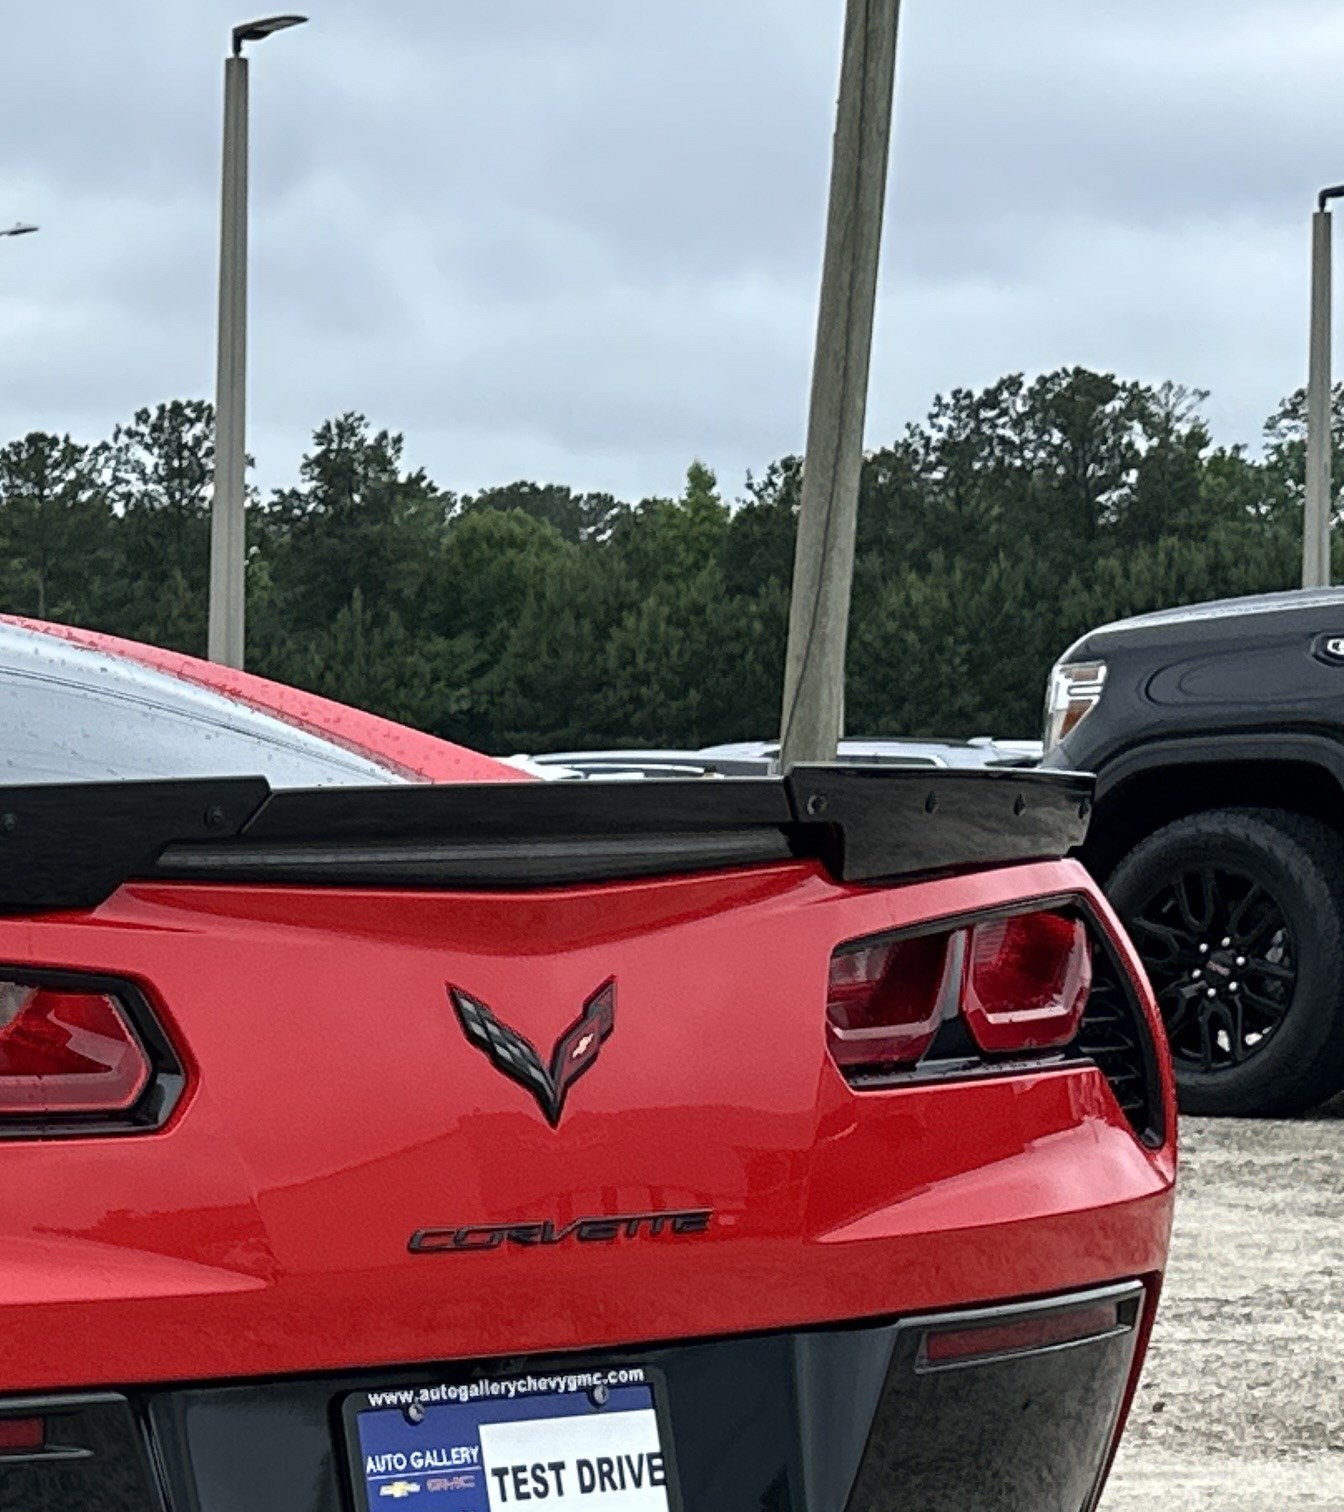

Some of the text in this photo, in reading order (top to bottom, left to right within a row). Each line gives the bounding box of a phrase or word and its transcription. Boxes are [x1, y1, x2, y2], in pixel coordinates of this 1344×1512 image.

[407, 1208, 714, 1254] CORVETTE
[367, 1368, 644, 1407] www.autogallerychevygmc.com
[366, 1445, 480, 1474] AUTO GALLERY
[491, 1451, 667, 1502] TEST DRIVE
